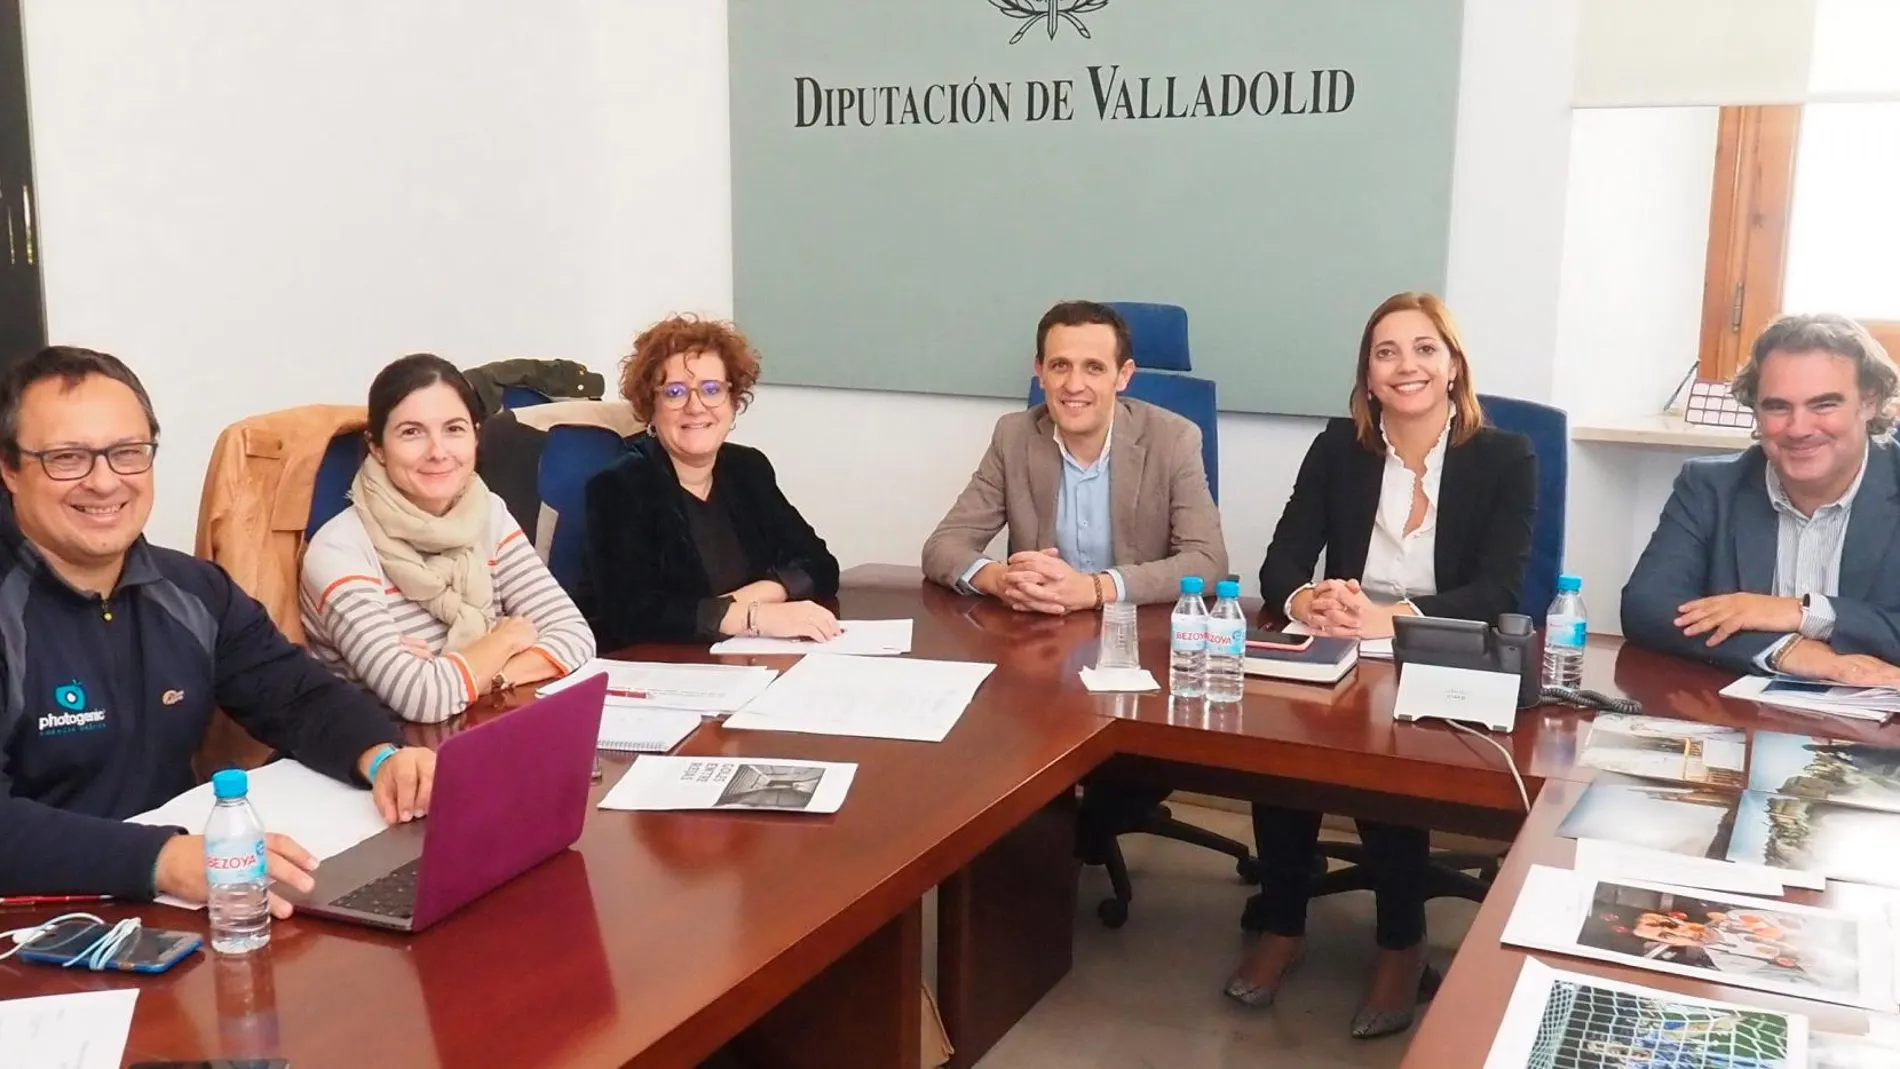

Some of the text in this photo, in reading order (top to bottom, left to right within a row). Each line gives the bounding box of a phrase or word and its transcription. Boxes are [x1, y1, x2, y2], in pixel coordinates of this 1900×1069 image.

[794, 64, 1355, 128] DIPUTACIÓN DE VALLADOLID
[38, 709, 106, 731] photogenic
